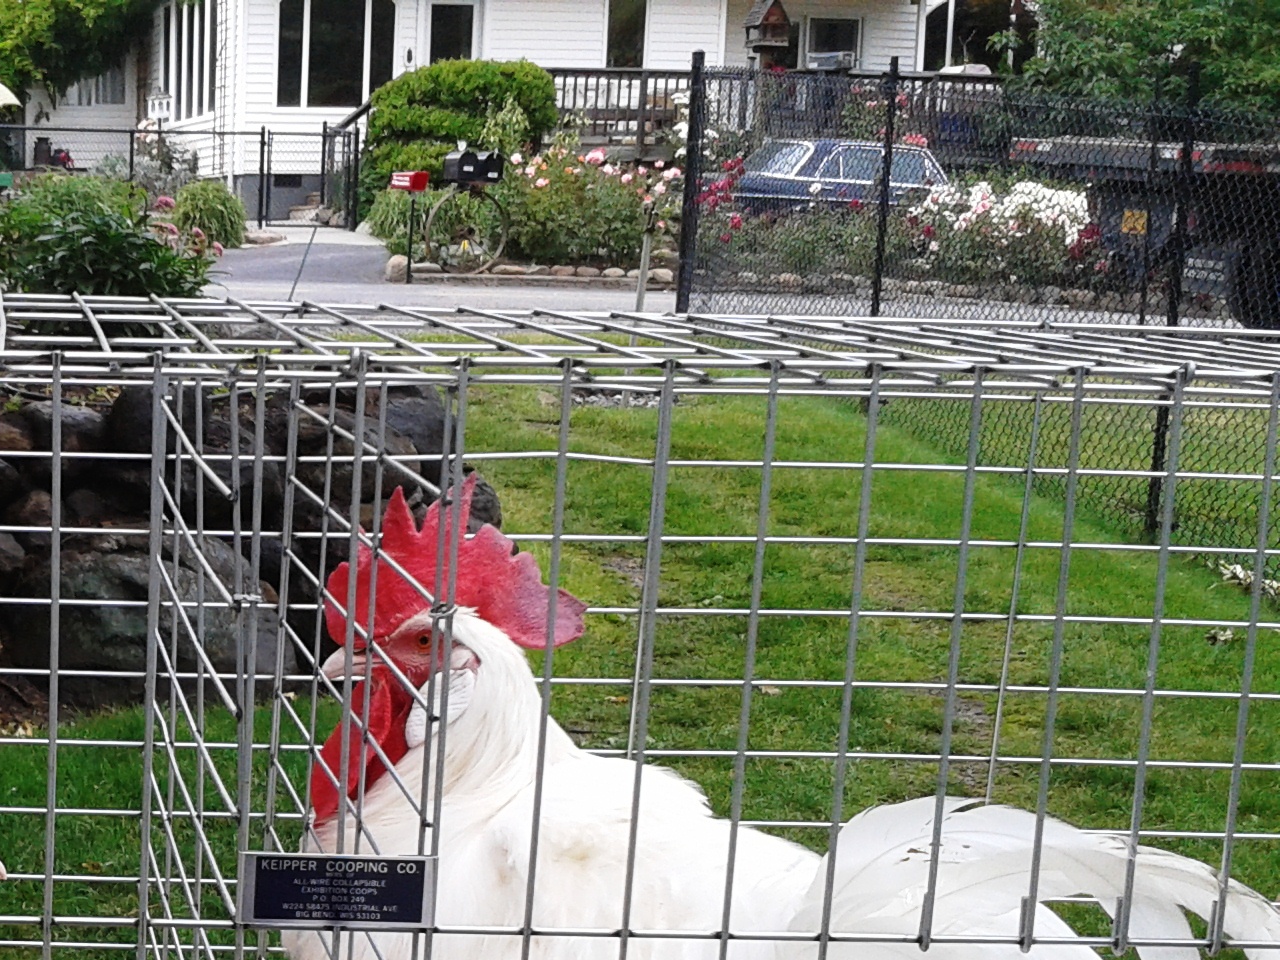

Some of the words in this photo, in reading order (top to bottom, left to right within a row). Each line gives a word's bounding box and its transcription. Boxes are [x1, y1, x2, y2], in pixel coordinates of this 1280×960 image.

[261, 859, 317, 871] KEIPPER
[326, 860, 388, 873] COOPING
[332, 878, 387, 887] COLLAPSIBLE
[300, 886, 348, 894] EXHIBITION
[349, 887, 378, 896] COOPS
[332, 903, 380, 912] INDUSTRIAL
[295, 910, 310, 918] BIG
[356, 912, 381, 920] 53103
